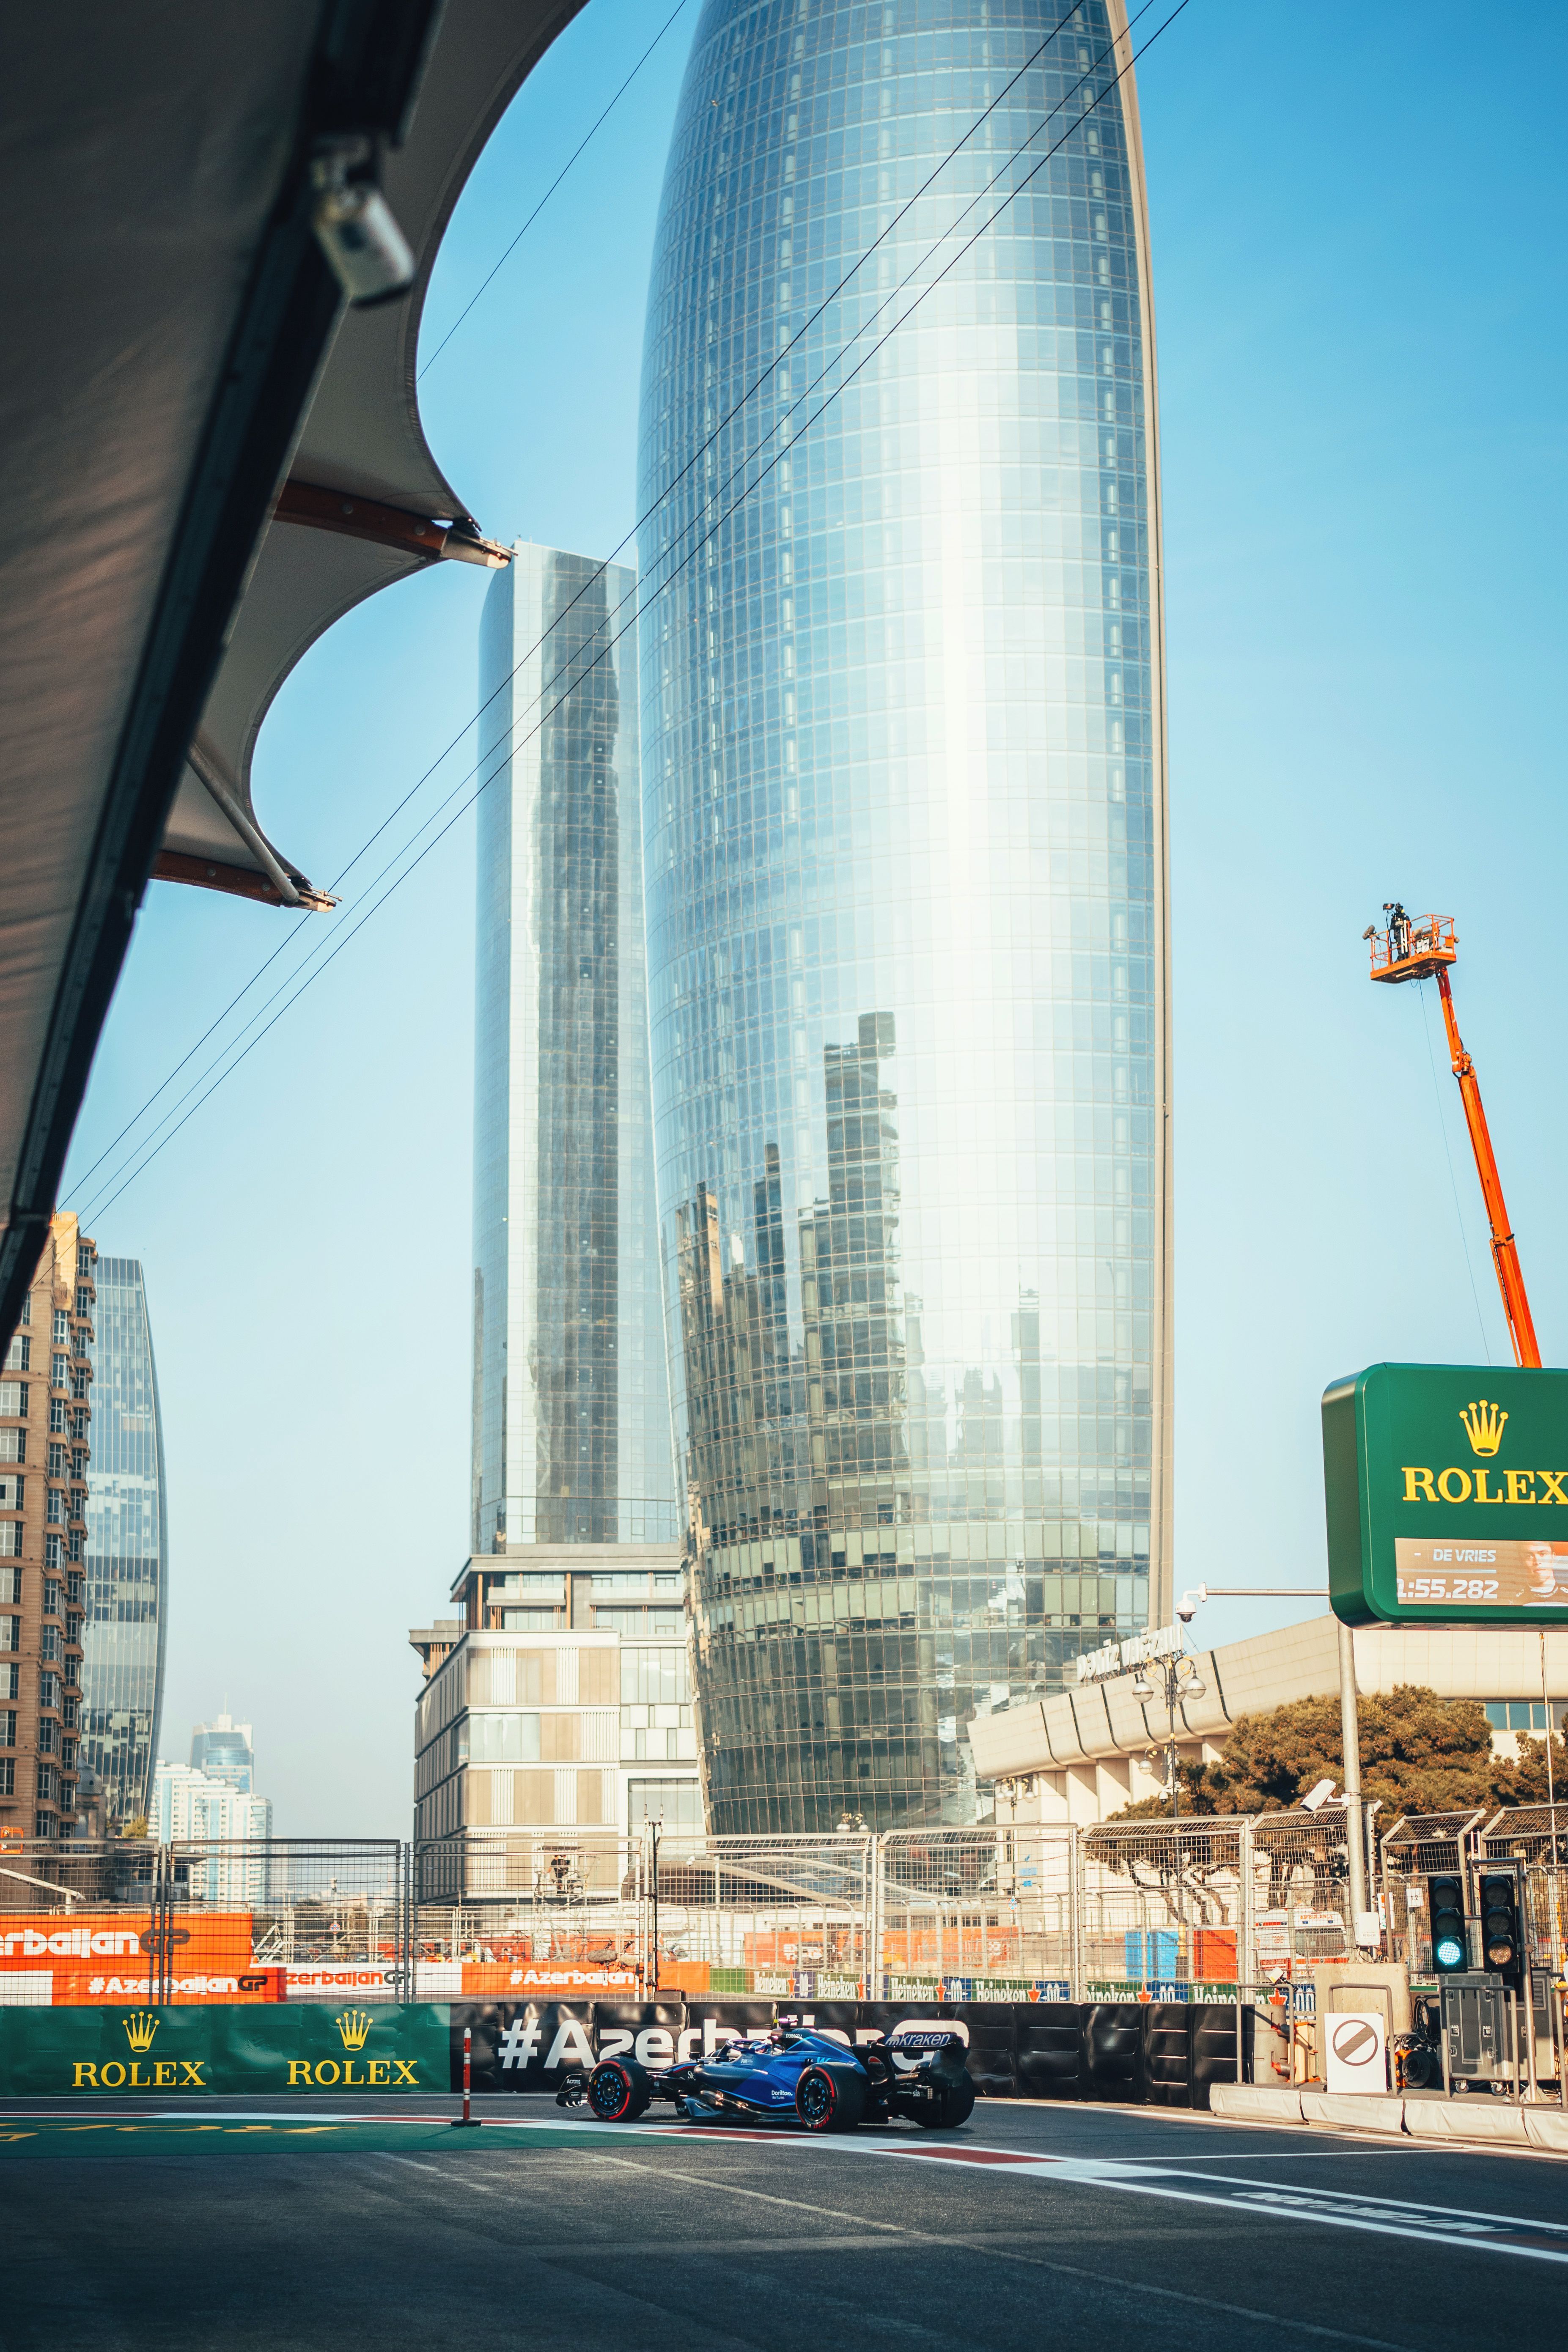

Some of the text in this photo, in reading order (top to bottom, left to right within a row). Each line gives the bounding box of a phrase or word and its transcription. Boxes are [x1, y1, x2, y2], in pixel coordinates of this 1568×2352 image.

[1401, 1467, 1568, 1504] ROLEX
[1433, 1548, 1496, 1562] DE VRIES
[1397, 1578, 1499, 1599] 1:55.282
[817, 1974, 856, 2000] Heineken
[891, 1978, 934, 2001] Heineken
[899, 2034, 950, 2046] kraken
[72, 2062, 206, 2086] ROLEX
[287, 2060, 419, 2085] ROLEX
